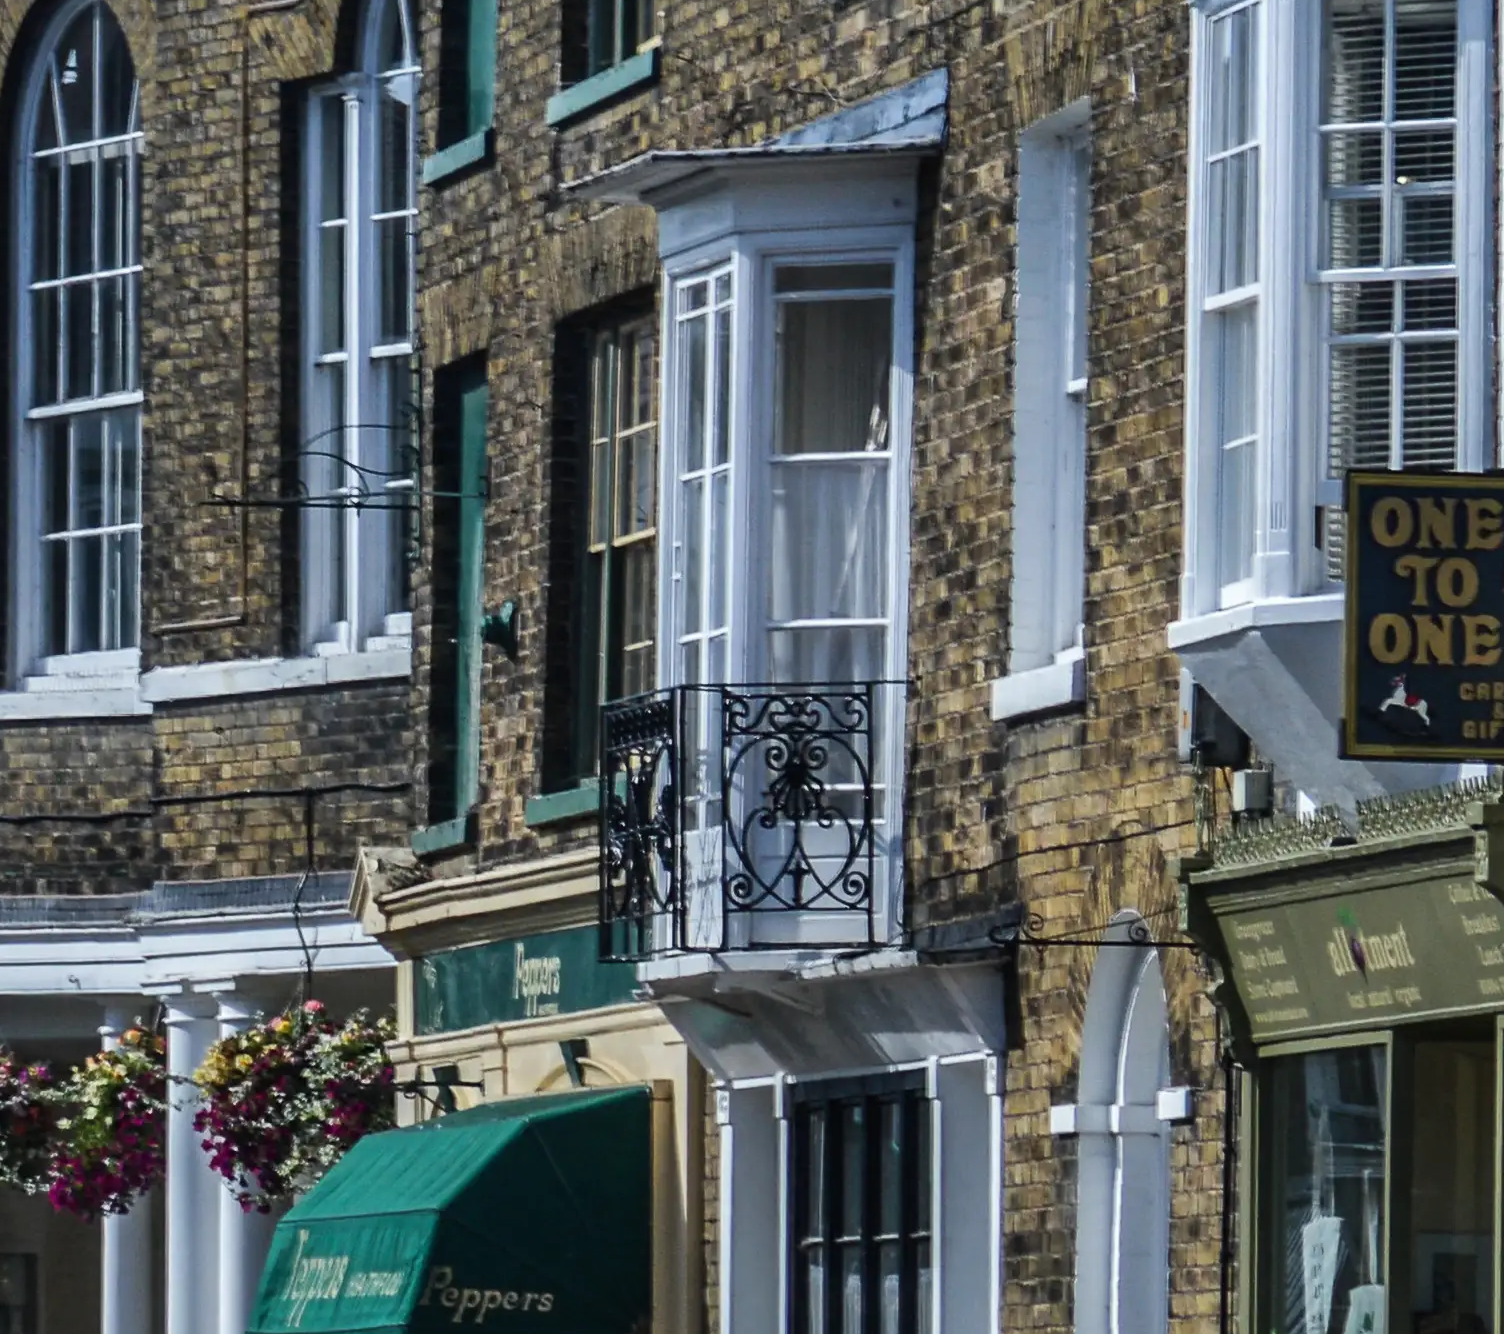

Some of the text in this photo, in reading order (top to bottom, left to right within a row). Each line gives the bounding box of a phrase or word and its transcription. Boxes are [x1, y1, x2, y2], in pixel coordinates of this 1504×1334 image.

[1371, 496, 1504, 551] ONE
[1394, 554, 1479, 609] TO
[1369, 613, 1502, 667] ONE
[419, 1265, 555, 1324] Peppers
